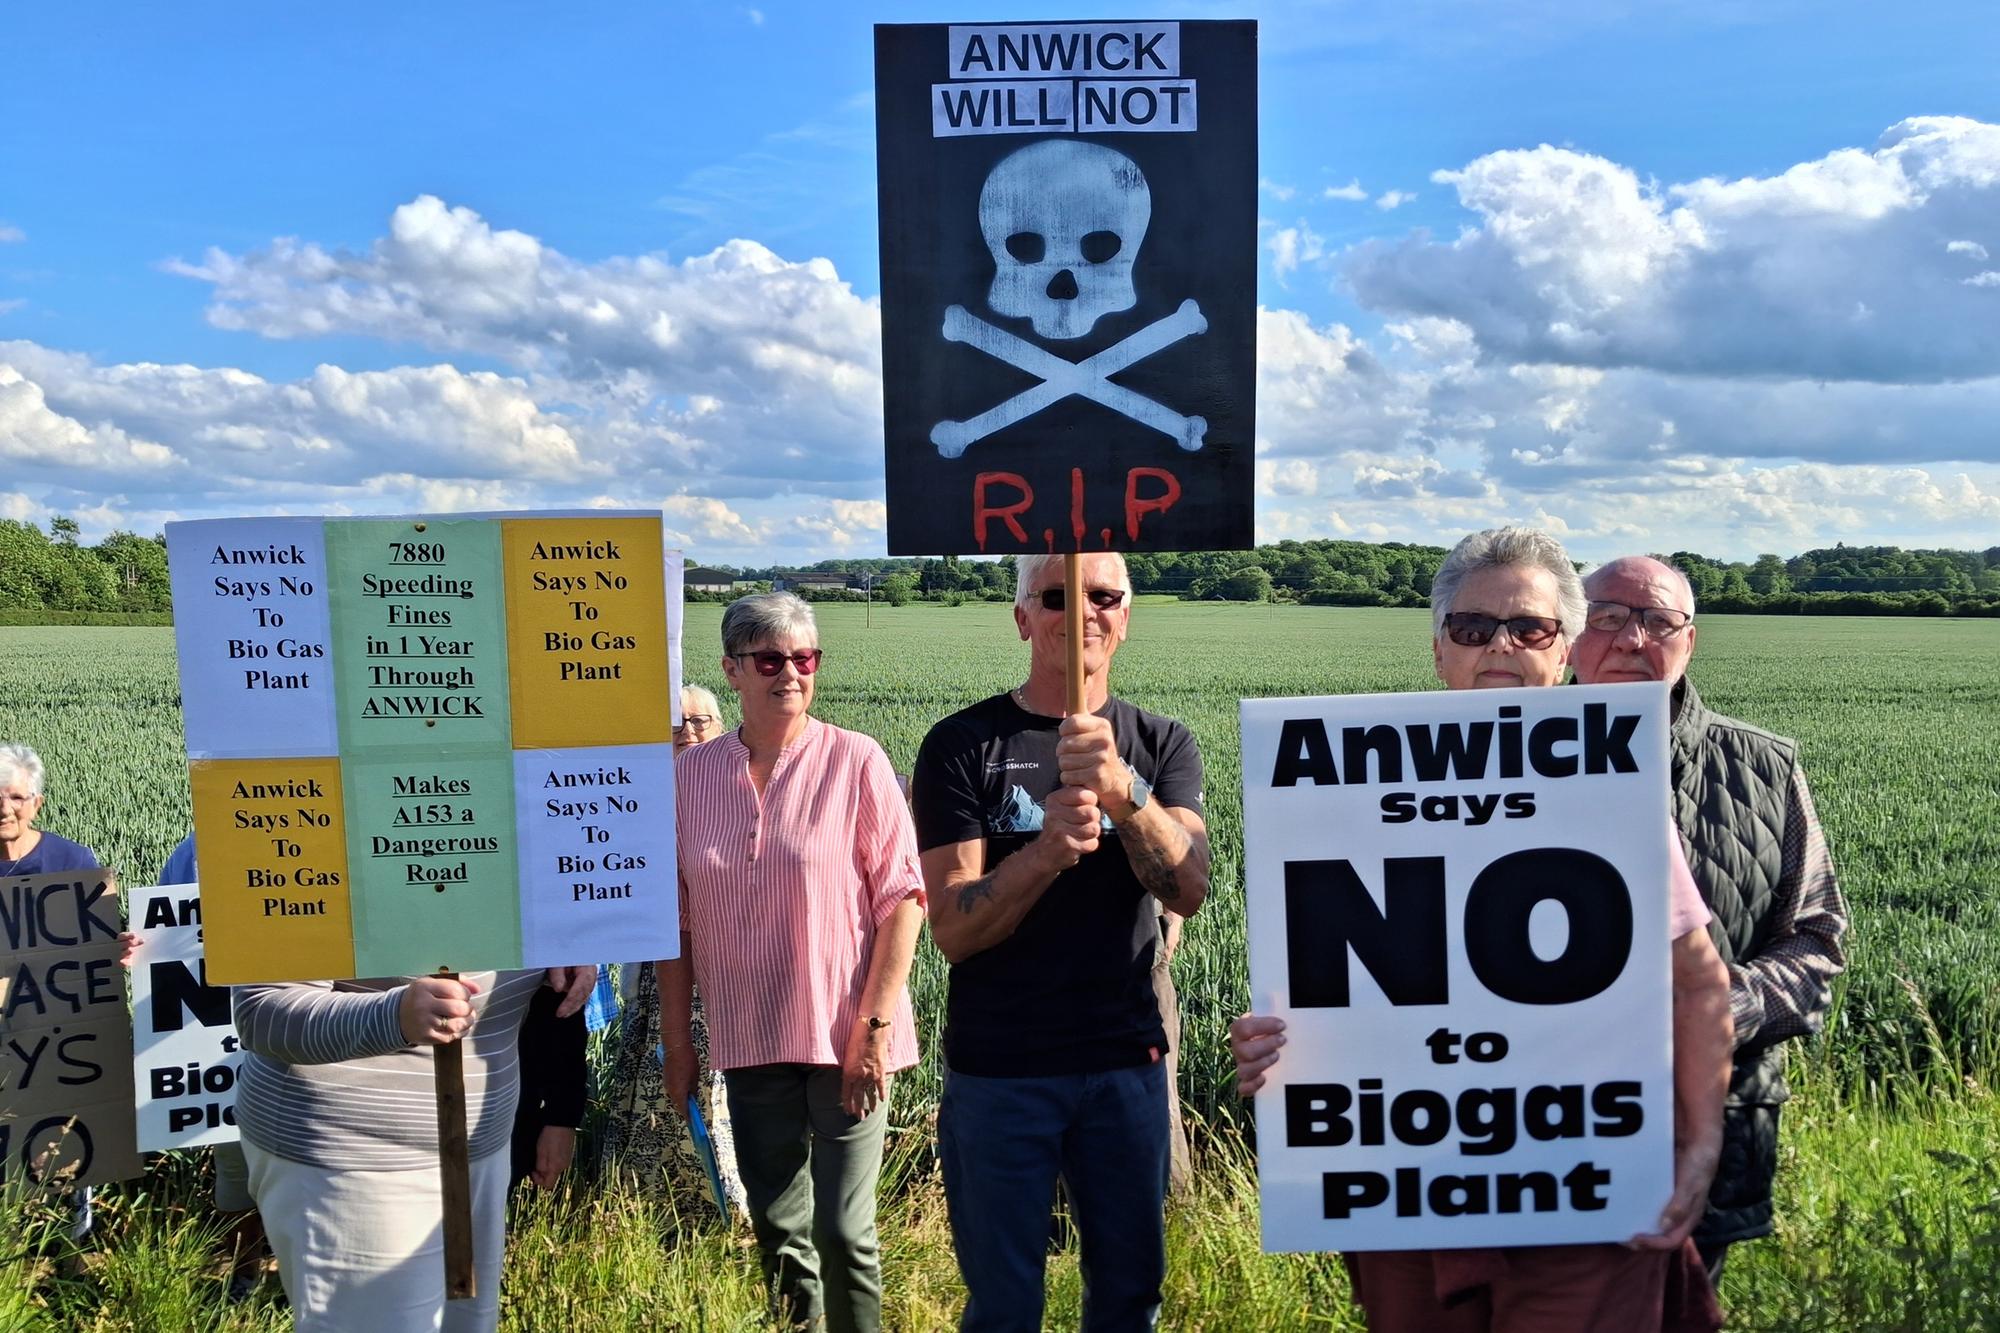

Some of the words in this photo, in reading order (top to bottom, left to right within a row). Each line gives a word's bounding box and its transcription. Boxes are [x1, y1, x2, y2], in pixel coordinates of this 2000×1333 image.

[959, 32, 1168, 72] ANWICK
[941, 88, 1067, 128] WILL
[1085, 86, 1191, 125] NOT
[210, 544, 306, 565] Anwick
[388, 543, 445, 563] 7880
[530, 540, 621, 560] Anwick
[214, 576, 271, 601] Says
[278, 576, 313, 596] No
[362, 573, 474, 599] Speeding
[533, 571, 587, 595] Says
[594, 570, 628, 590] No
[252, 608, 284, 627] To
[387, 605, 452, 625] Fines
[568, 601, 598, 620] To
[227, 639, 268, 658] Bio
[276, 638, 324, 658] Gas
[367, 635, 389, 655] in
[399, 635, 408, 655] 1
[418, 635, 474, 655] Year
[544, 632, 583, 650] Bio
[591, 631, 636, 650] Gas
[244, 670, 310, 689] Plant
[368, 666, 474, 690] Through
[560, 661, 621, 680] Plant
[362, 696, 483, 716] ANWICK
[1270, 702, 1642, 788] Anwick
[392, 775, 471, 795] Makes
[543, 767, 632, 788] Anwick
[231, 779, 323, 799] Anwick
[392, 804, 453, 824] A153
[461, 808, 474, 822] a
[546, 798, 599, 820] Says
[606, 795, 638, 814] No
[1379, 791, 1537, 826] says
[234, 809, 289, 833] Says
[296, 808, 331, 827] No
[581, 825, 610, 843] To
[271, 839, 302, 857] To
[371, 835, 498, 857] Dangerous
[406, 862, 468, 882] Road
[557, 855, 595, 874] Bio
[602, 852, 646, 871] Gas
[245, 868, 286, 887] Bio
[294, 867, 340, 886] Gas
[572, 882, 633, 901] Plant
[263, 898, 326, 916] Plant
[1283, 846, 1634, 1009] NO
[1425, 1027, 1510, 1065] to
[150, 1062, 241, 1100] Bio
[1284, 1077, 1645, 1157] Biogas
[1321, 1160, 1611, 1220] Plant
